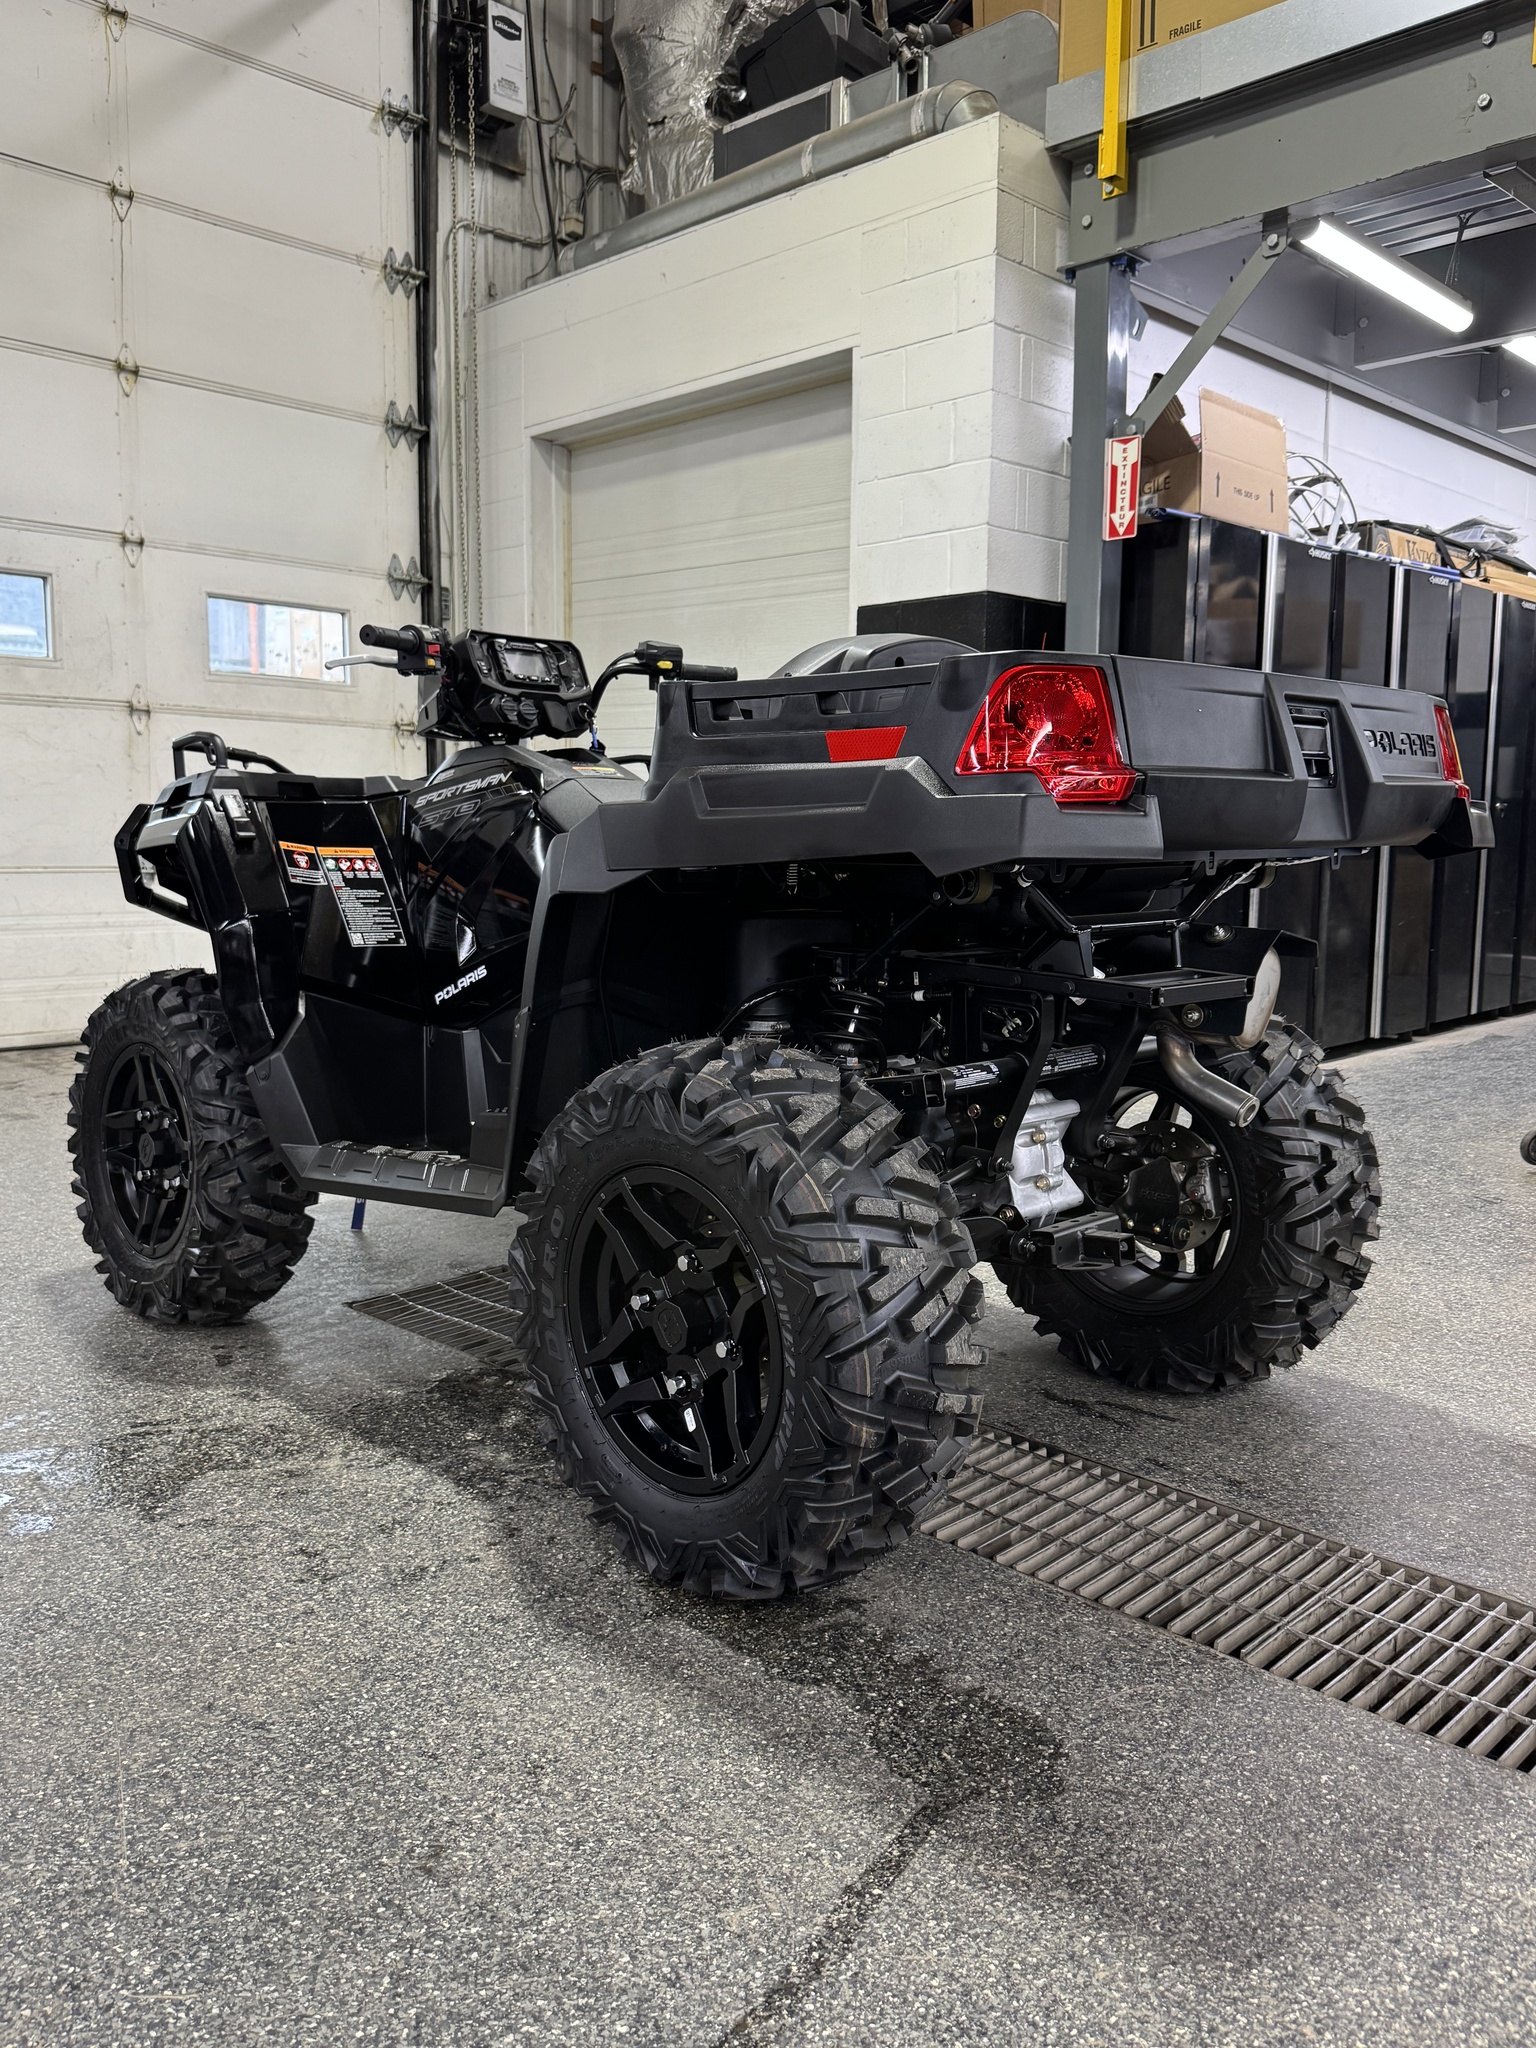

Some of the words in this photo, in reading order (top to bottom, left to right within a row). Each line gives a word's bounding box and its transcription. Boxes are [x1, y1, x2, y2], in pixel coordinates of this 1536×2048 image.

[1169, 19, 1202, 40] FRAGILE
[1118, 447, 1129, 529] EXTINCTEUR
[1142, 475, 1170, 494] GILE
[1233, 486, 1243, 496] THIS
[1243, 490, 1253, 500] SIDE
[1363, 729, 1437, 757] POLARIS
[413, 771, 513, 809] SPORTSMAN
[418, 799, 481, 829] 570
[434, 964, 488, 1005] POLARIS
[542, 1203, 566, 1363] DURO
